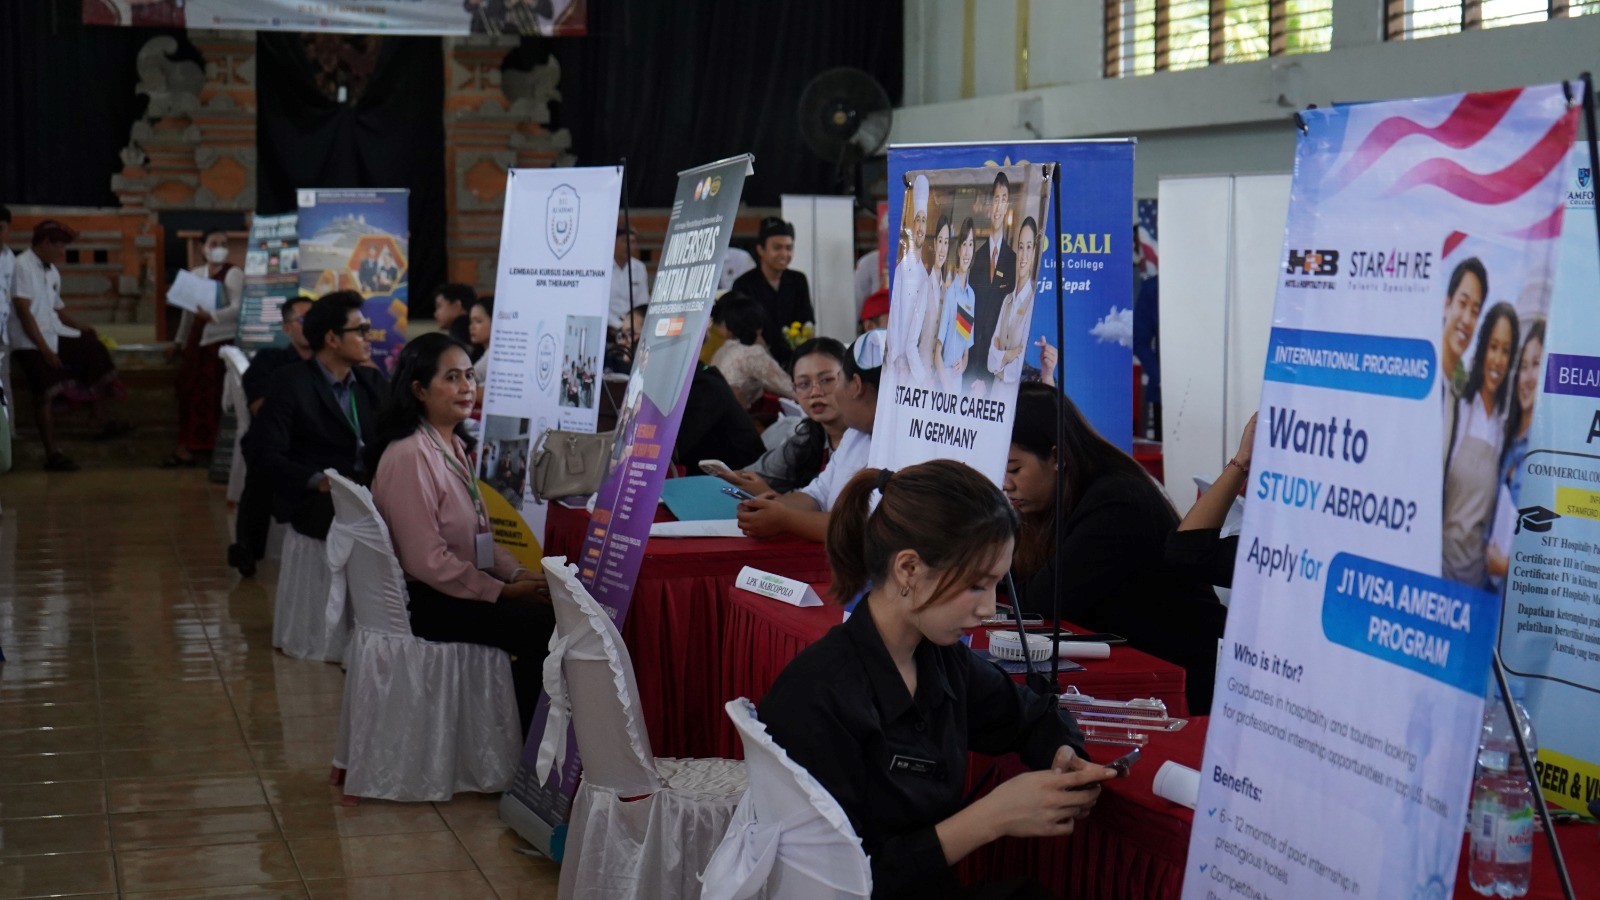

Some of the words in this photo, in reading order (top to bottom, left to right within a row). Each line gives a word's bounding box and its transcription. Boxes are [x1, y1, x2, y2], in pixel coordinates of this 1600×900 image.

[1566, 191, 1595, 200] AMFO
[664, 225, 721, 267] UNIVERSITAS
[1061, 233, 1111, 254] BALI
[1044, 258, 1065, 269] Lie
[1067, 259, 1104, 271] College
[1036, 276, 1053, 293] rja
[1062, 278, 1091, 294] epat
[1275, 345, 1360, 371] INTERNATIONAL
[1361, 353, 1430, 380] PROGRAMS
[1558, 367, 1600, 388] BELAJ
[895, 385, 928, 409] START
[931, 390, 957, 415] YOUR
[960, 396, 1006, 423] CAREER
[909, 418, 923, 439] IN
[924, 421, 978, 450] GERMANY
[1270, 406, 1337, 459] Want
[1342, 418, 1368, 464] to
[1528, 463, 1589, 482] COMMERCIAL
[1257, 470, 1322, 511] STUDY
[1323, 484, 1417, 533] ABROAD?
[1567, 505, 1599, 518] STAMFORD
[1247, 536, 1298, 582] Apply
[1299, 549, 1323, 581] for
[1515, 551, 1561, 567] Certificate
[1563, 557, 1573, 569] III
[1573, 559, 1580, 570] in
[1541, 535, 1559, 547] SIT
[1561, 538, 1592, 556] Hospitality
[746, 576, 760, 587] LPK
[759, 580, 794, 597] MARCOPOLO
[1512, 581, 1548, 595] Diploma
[1551, 586, 1561, 596] of
[1514, 566, 1559, 581] Certificate
[1561, 572, 1572, 582] IV
[1337, 568, 1355, 596] J1
[1358, 572, 1394, 609] VISA
[1396, 584, 1471, 633] AMERICA
[1518, 603, 1555, 618] Dapatkan
[1367, 615, 1450, 668] PROGRAM
[1517, 621, 1553, 634] pelatihan
[1234, 642, 1258, 667] Who
[1260, 651, 1270, 671] is
[1272, 655, 1281, 675] it
[1282, 659, 1304, 682] for?
[1227, 676, 1274, 707] Graduates
[1275, 696, 1284, 710] in
[1285, 698, 1329, 732] hospitality
[1329, 719, 1349, 737] and
[1350, 727, 1383, 752] tourism
[1384, 737, 1418, 773] looking
[1223, 702, 1236, 719] for
[1236, 711, 1286, 741] professional
[1287, 732, 1326, 761] internship
[1328, 749, 1384, 786] opportunities
[1213, 765, 1262, 802] Benefits:
[1534, 760, 1569, 795] REER
[1570, 772, 1581, 800] &
[1586, 776, 1600, 803] VI
[1215, 836, 1262, 870] prestigious
[1264, 857, 1289, 885] hotels
[1219, 808, 1226, 823] 6
[1234, 815, 1245, 833] 12
[1244, 822, 1277, 850] months
[1278, 839, 1288, 853] of
[1288, 845, 1309, 868] paid
[1309, 856, 1351, 892] internship
[1210, 864, 1264, 900] Competitive
